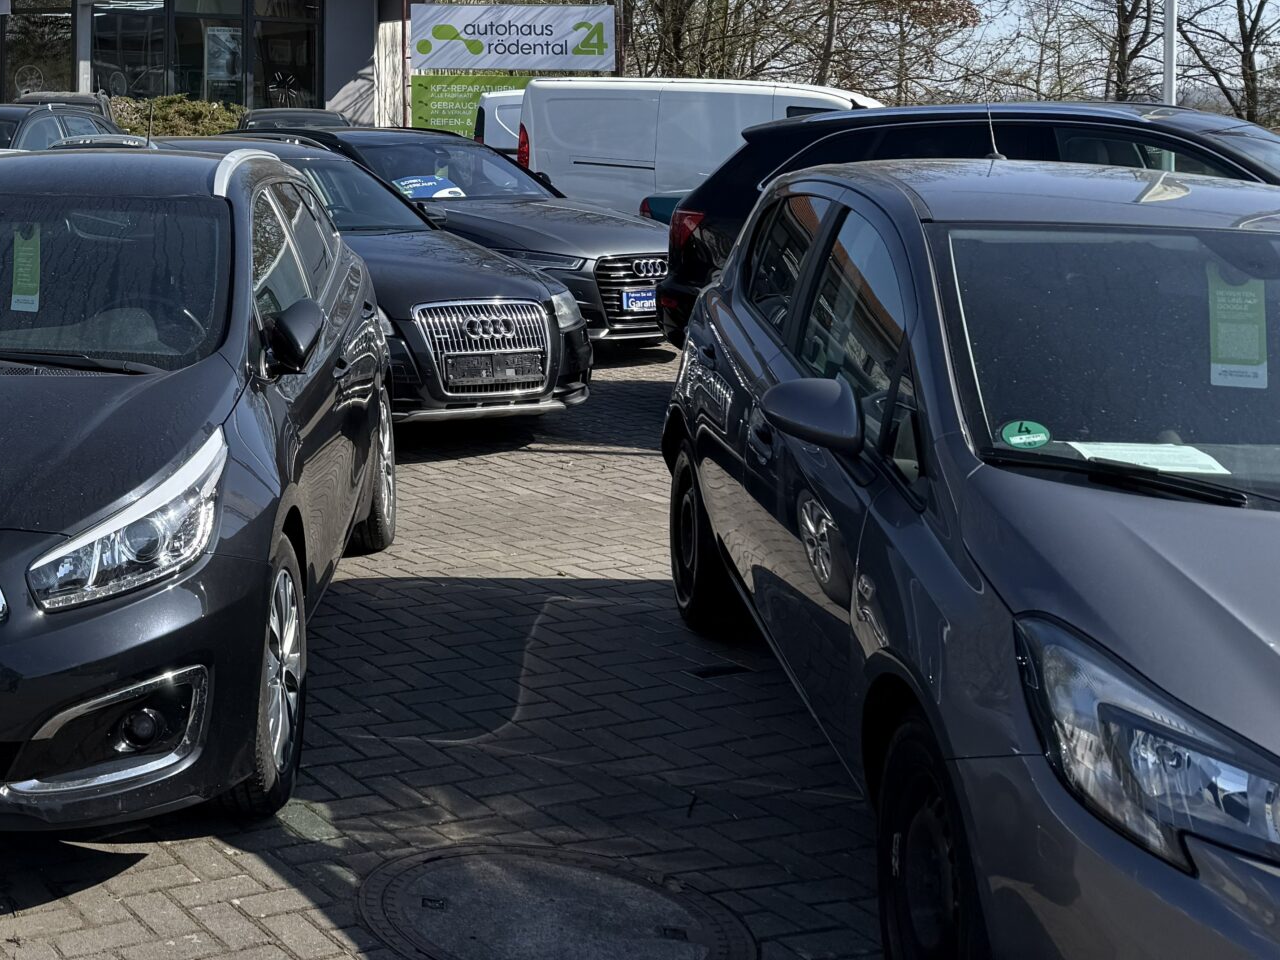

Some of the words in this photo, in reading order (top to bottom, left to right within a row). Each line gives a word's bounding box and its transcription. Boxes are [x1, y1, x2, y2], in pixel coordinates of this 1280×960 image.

[463, 20, 554, 37] autohaus
[571, 21, 609, 56] 24
[487, 39, 569, 56] rödental
[430, 118, 465, 126] REIFEN-
[466, 118, 473, 126] &
[1017, 422, 1032, 435] 4
